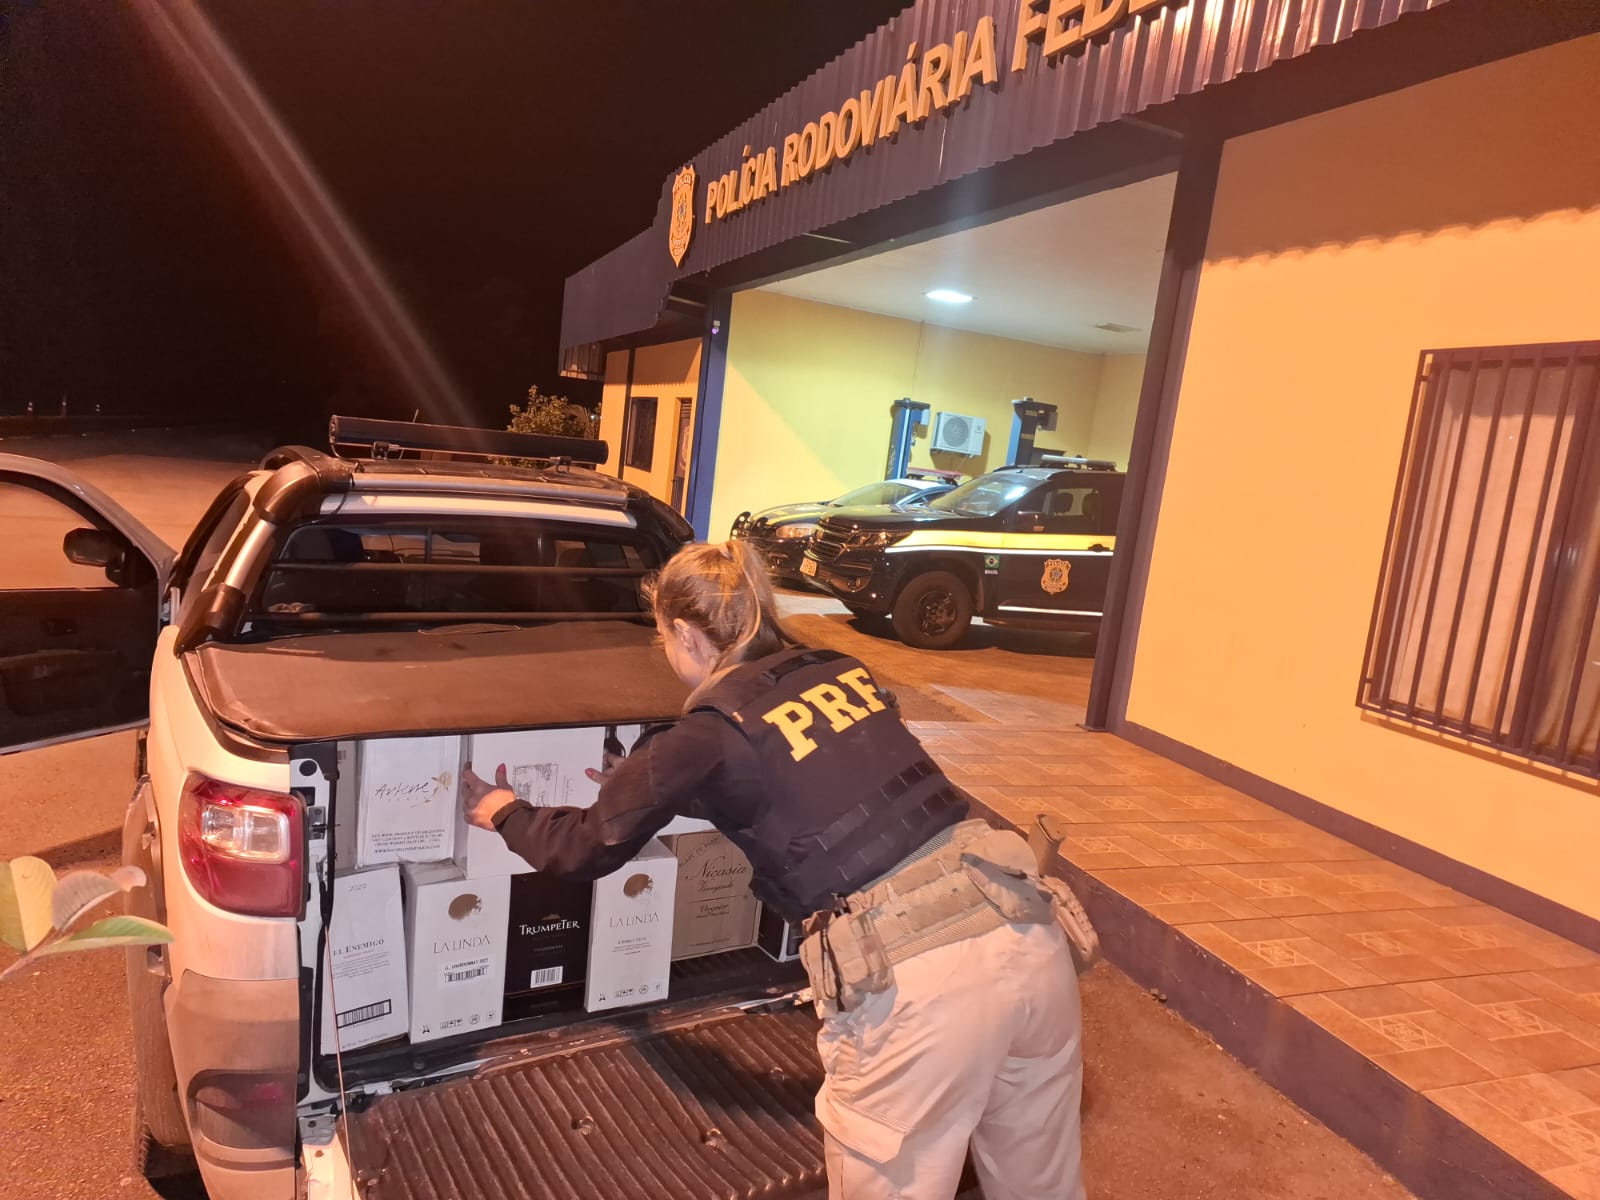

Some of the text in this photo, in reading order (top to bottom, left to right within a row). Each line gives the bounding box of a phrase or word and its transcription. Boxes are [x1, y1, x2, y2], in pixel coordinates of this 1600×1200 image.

[705, 144, 777, 224] POLÍCIA
[781, 15, 998, 188] RODOVIÁRIA
[761, 667, 887, 762] PRF
[519, 919, 580, 936] TRUMPETER
[609, 912, 660, 928] LA LINDA
[346, 938, 384, 953] ENEMIGO
[433, 935, 491, 954] LA LINDA
